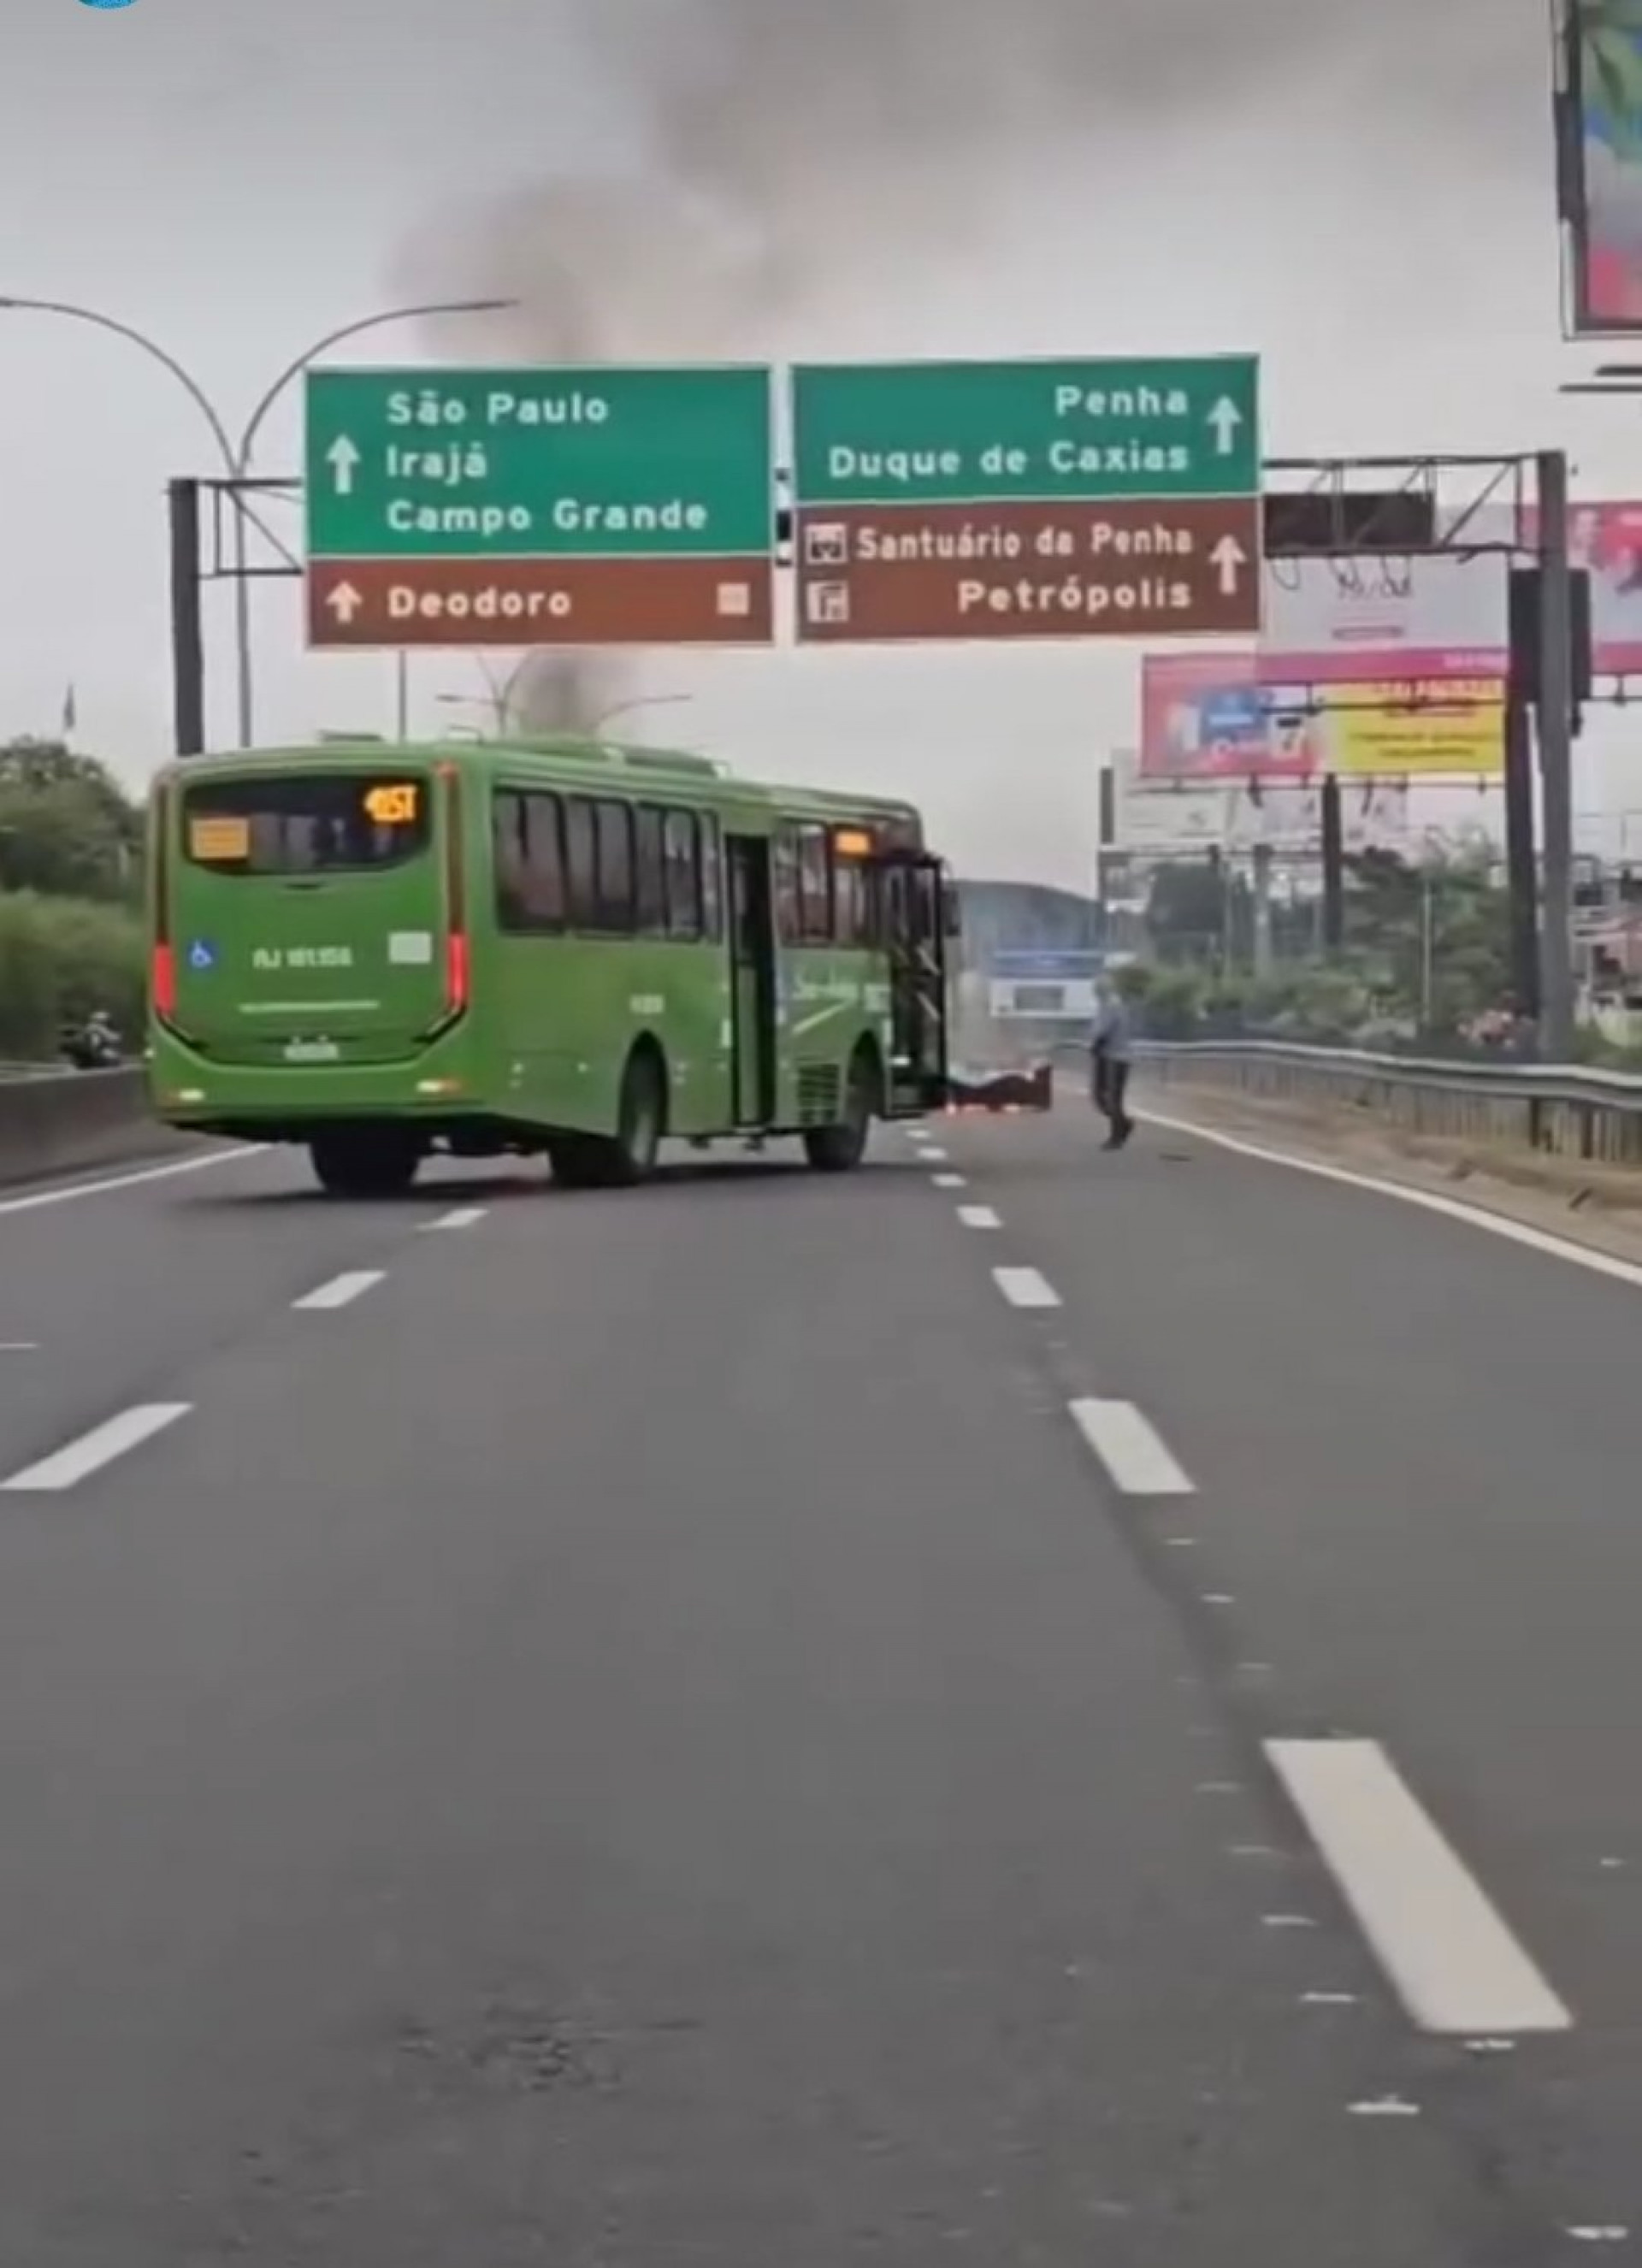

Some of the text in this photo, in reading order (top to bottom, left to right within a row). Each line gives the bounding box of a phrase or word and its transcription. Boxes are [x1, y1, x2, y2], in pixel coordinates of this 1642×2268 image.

[386, 391, 609, 425] São Paulo
[1056, 383, 1189, 416] Penha
[386, 442, 487, 484] Irajá
[830, 440, 1189, 479] Duque de Caxias
[386, 499, 708, 536] Campo Grande
[857, 522, 1194, 560] Santuário da Penha
[387, 586, 571, 617] Deodoro
[959, 575, 1193, 614] Petrópolis
